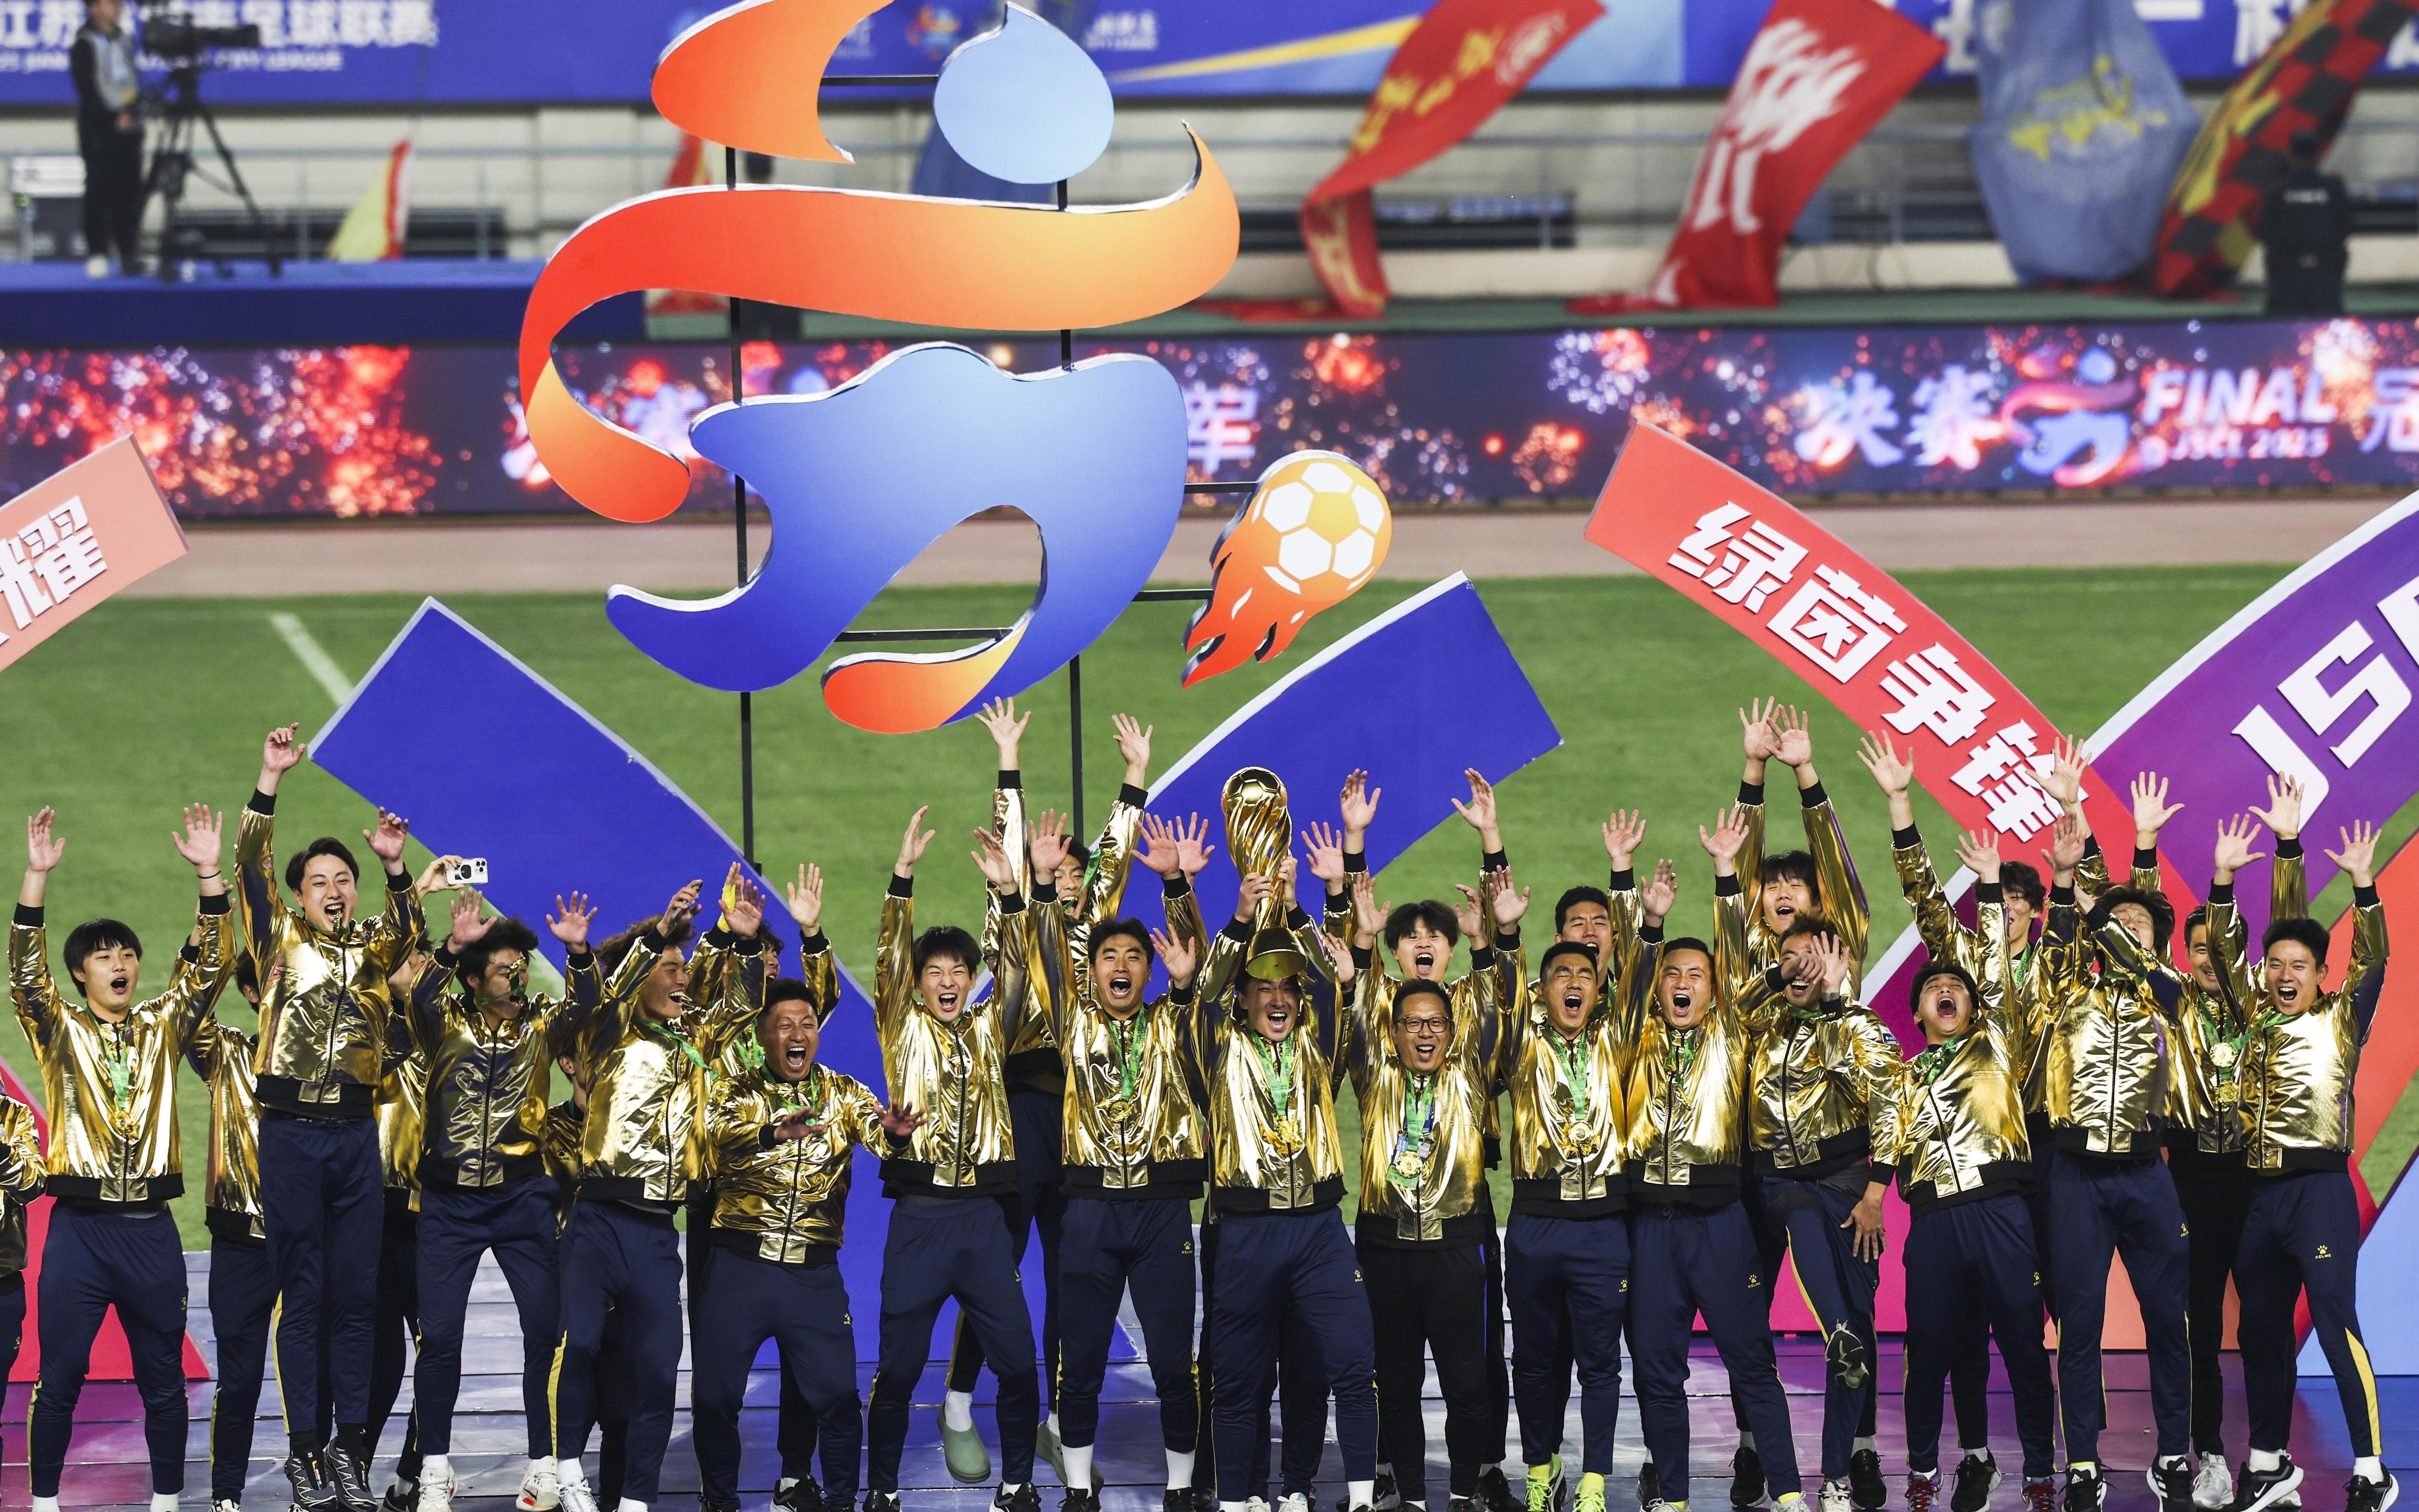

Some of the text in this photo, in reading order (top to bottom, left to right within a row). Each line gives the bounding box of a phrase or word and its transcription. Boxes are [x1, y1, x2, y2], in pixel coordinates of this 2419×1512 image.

[1793, 365, 2004, 470] 决赛
[2141, 368, 2338, 424] FINAL
[2249, 428, 2330, 460] 2025
[0, 495, 108, 646] 耀
[1667, 500, 2089, 843] 绿茵争锋
